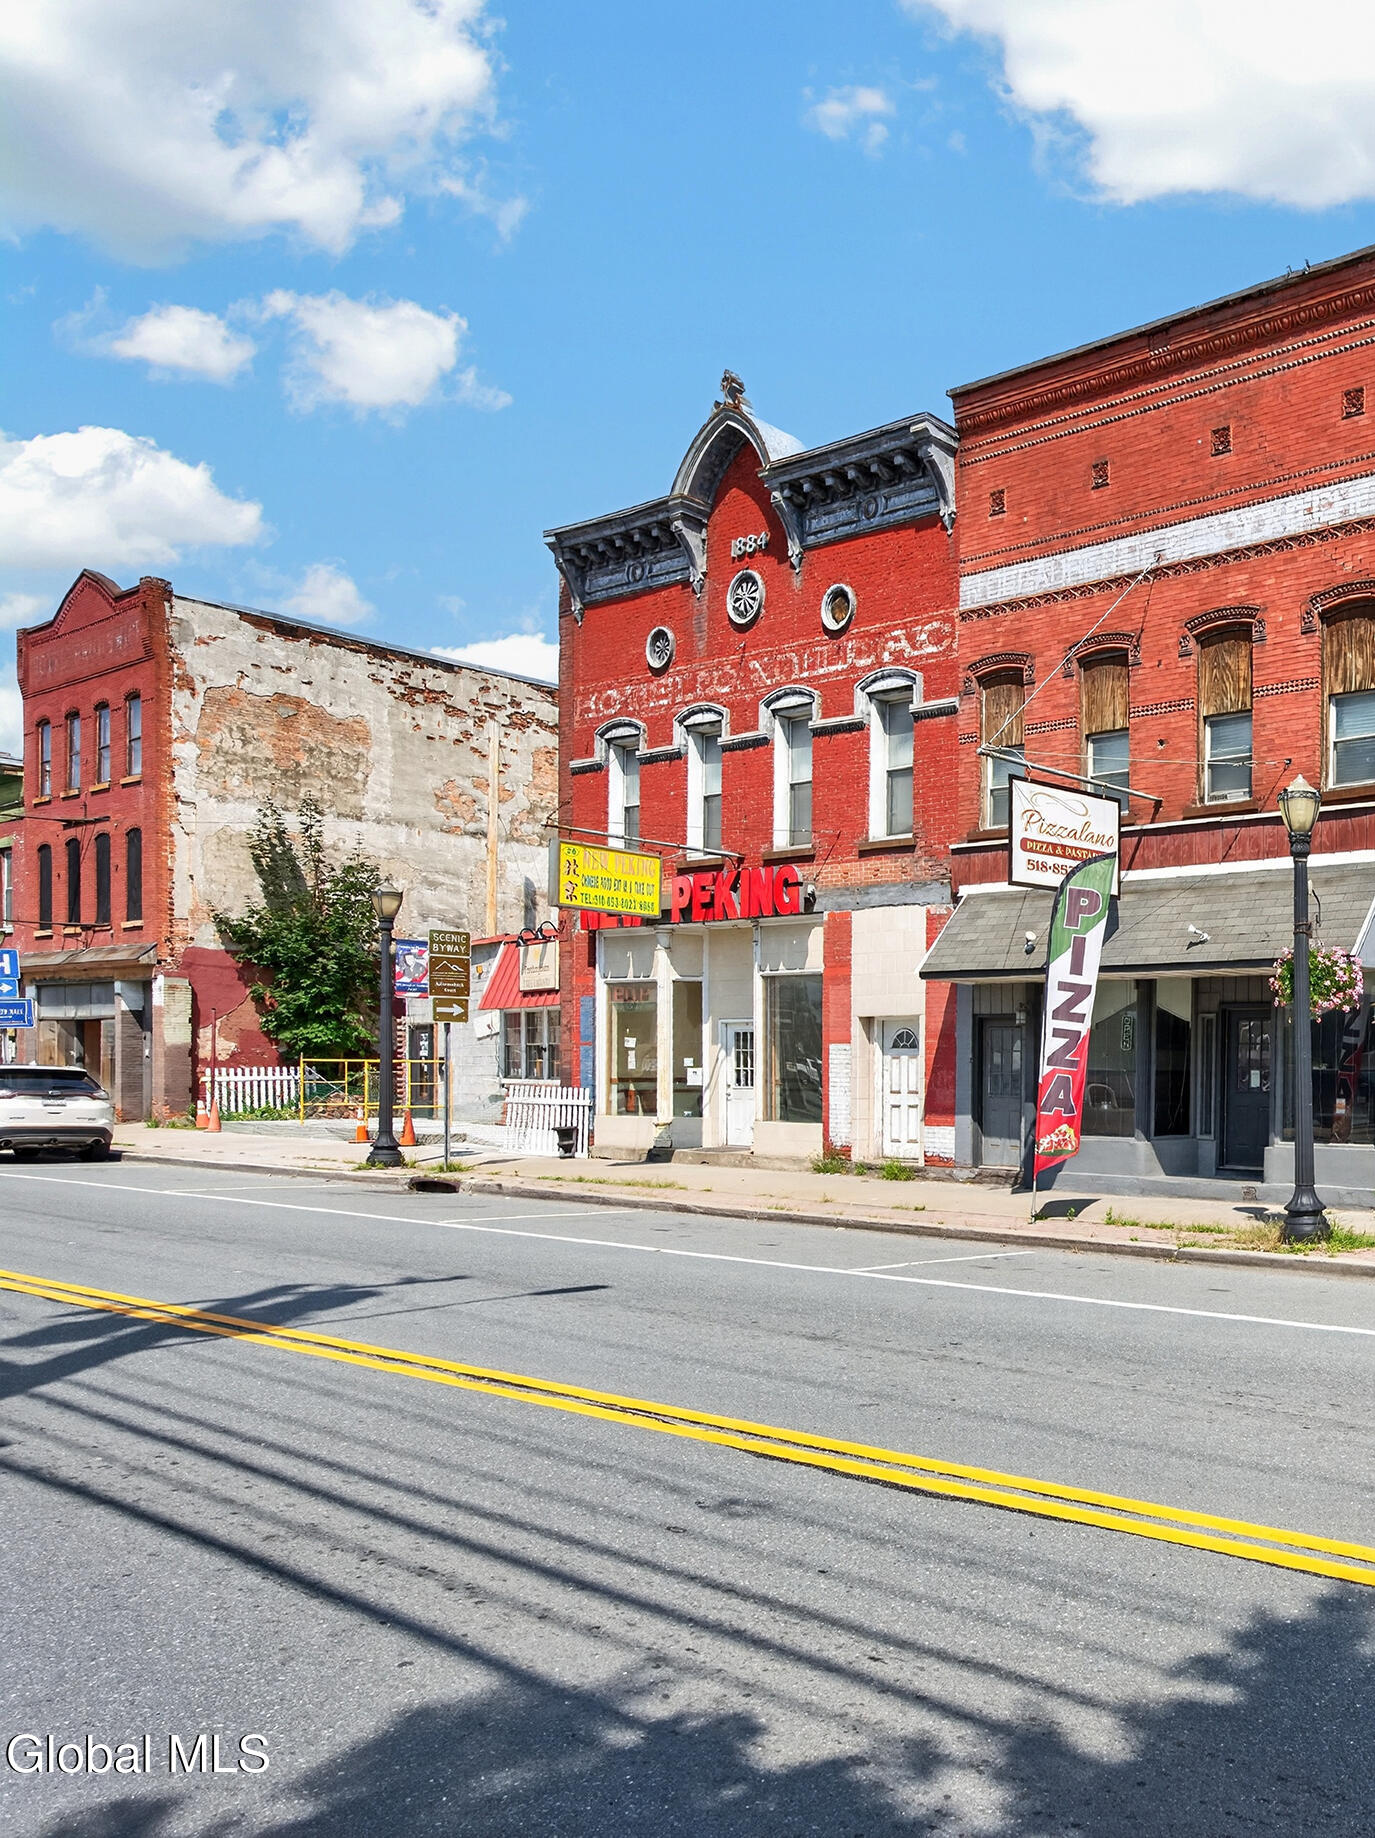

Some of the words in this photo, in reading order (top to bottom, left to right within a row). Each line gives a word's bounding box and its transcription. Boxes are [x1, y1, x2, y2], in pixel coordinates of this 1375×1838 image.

[731, 531, 770, 557] 1884
[1021, 808, 1115, 847] Pizzalano
[1026, 840, 1053, 854] PIZZA
[1055, 846, 1064, 855] &
[671, 865, 800, 923] PEKING
[432, 943, 467, 954] BYWAY
[433, 933, 467, 943] SCENIC
[1039, 886, 1102, 1117] PIZZA
